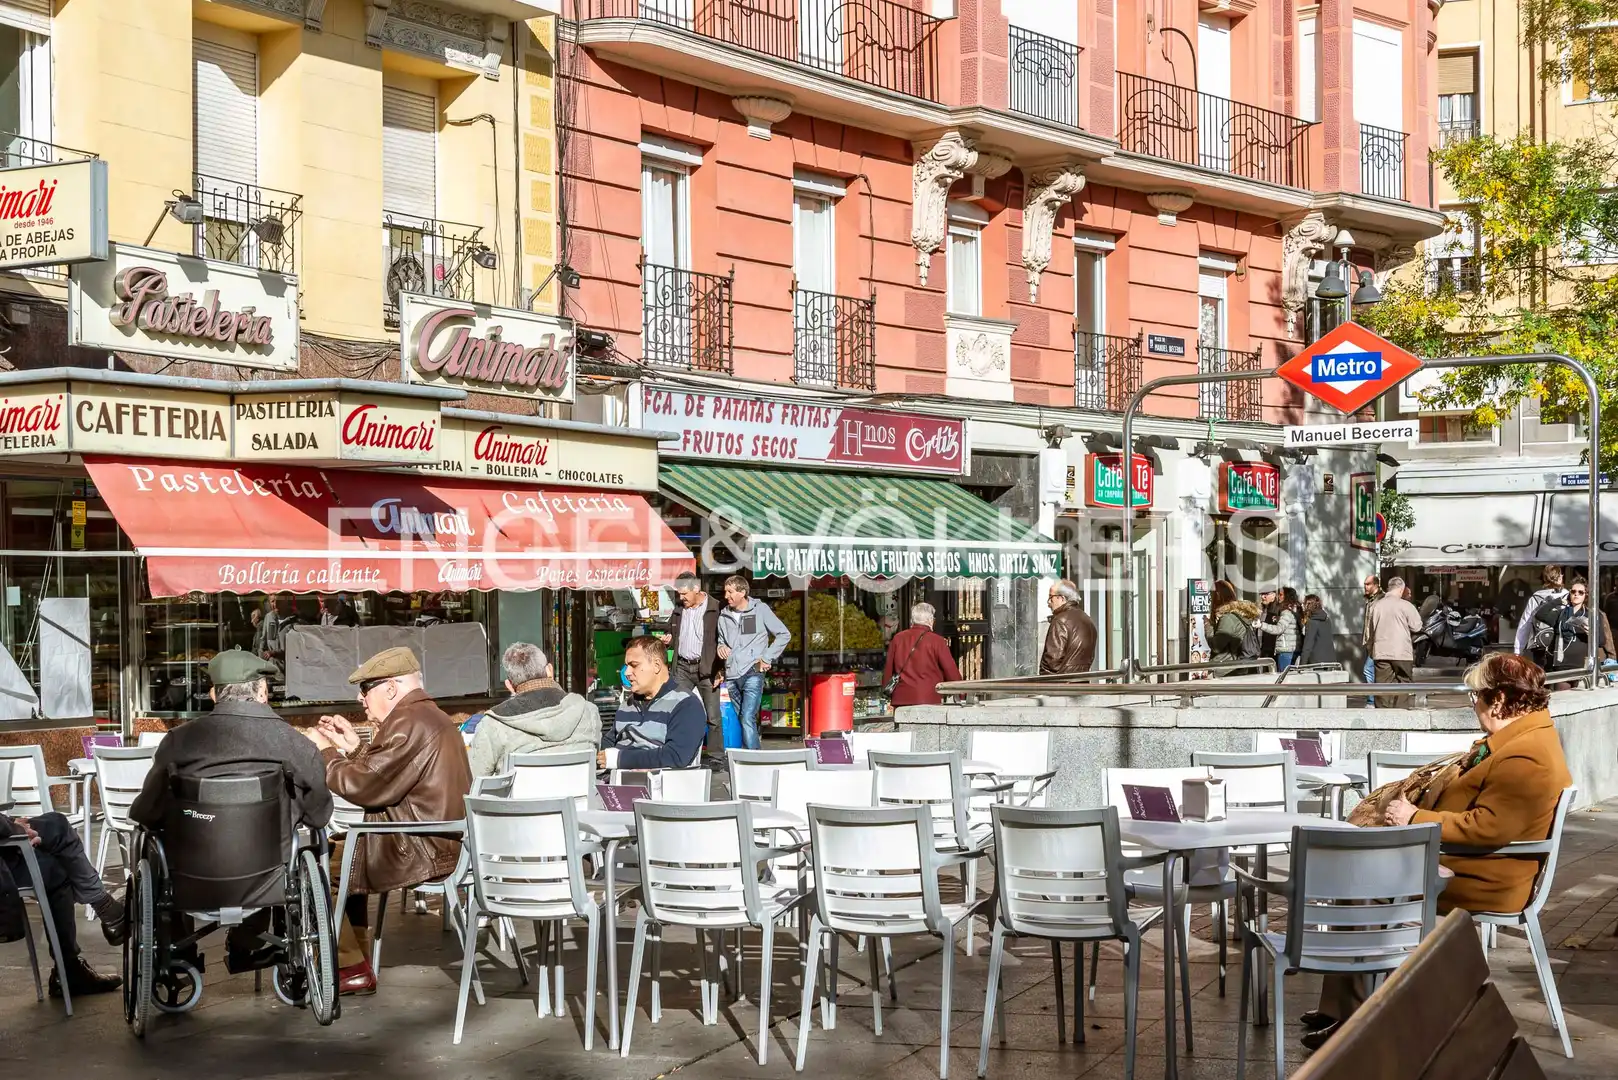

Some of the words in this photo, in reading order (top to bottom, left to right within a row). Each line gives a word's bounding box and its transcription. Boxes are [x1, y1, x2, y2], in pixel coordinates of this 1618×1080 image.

[14, 221, 35, 229] desde
[38, 218, 54, 227] 1946
[6, 234, 22, 247] DE
[26, 228, 74, 244] ABEJAS
[0, 250, 7, 260] A
[11, 244, 57, 259] PROPIA
[410, 308, 576, 389] Animari
[1317, 358, 1377, 377] Metro
[236, 398, 335, 420] PASTELERIA
[643, 386, 677, 416] FCA.
[685, 394, 704, 418] DE
[713, 397, 774, 424] PATATAS
[781, 404, 832, 428] FRITAS
[76, 400, 227, 442] CAFETERIA
[342, 404, 436, 452] Animari
[251, 432, 319, 451] SALADA
[474, 425, 549, 467] Animari
[682, 429, 743, 456] FRUTOS
[751, 434, 798, 459] SECOS
[1291, 427, 1347, 443] Manuel
[1352, 426, 1413, 440] Becerra
[487, 464, 539, 479] BOLLERIA
[558, 469, 624, 485] CHOCOLATES
[1098, 462, 1123, 488] Café
[1136, 464, 1149, 490] Té
[1231, 470, 1253, 495] Café
[1256, 472, 1264, 496] &
[1264, 472, 1275, 496] Té
[371, 498, 475, 536] Animari
[437, 560, 482, 583] Animari
[756, 547, 784, 571] FCA.
[787, 548, 835, 572] PATATAS
[839, 549, 878, 573] FRITAS
[881, 550, 924, 573] FRUTOS
[927, 551, 961, 574] SECOS
[968, 552, 997, 574] HNOS.
[1000, 553, 1029, 574] ORTIZ
[218, 563, 300, 586] Bollería
[307, 562, 380, 584] caliente
[537, 566, 581, 583] Panes
[586, 562, 653, 587] especiales
[192, 810, 215, 822] Breezy
